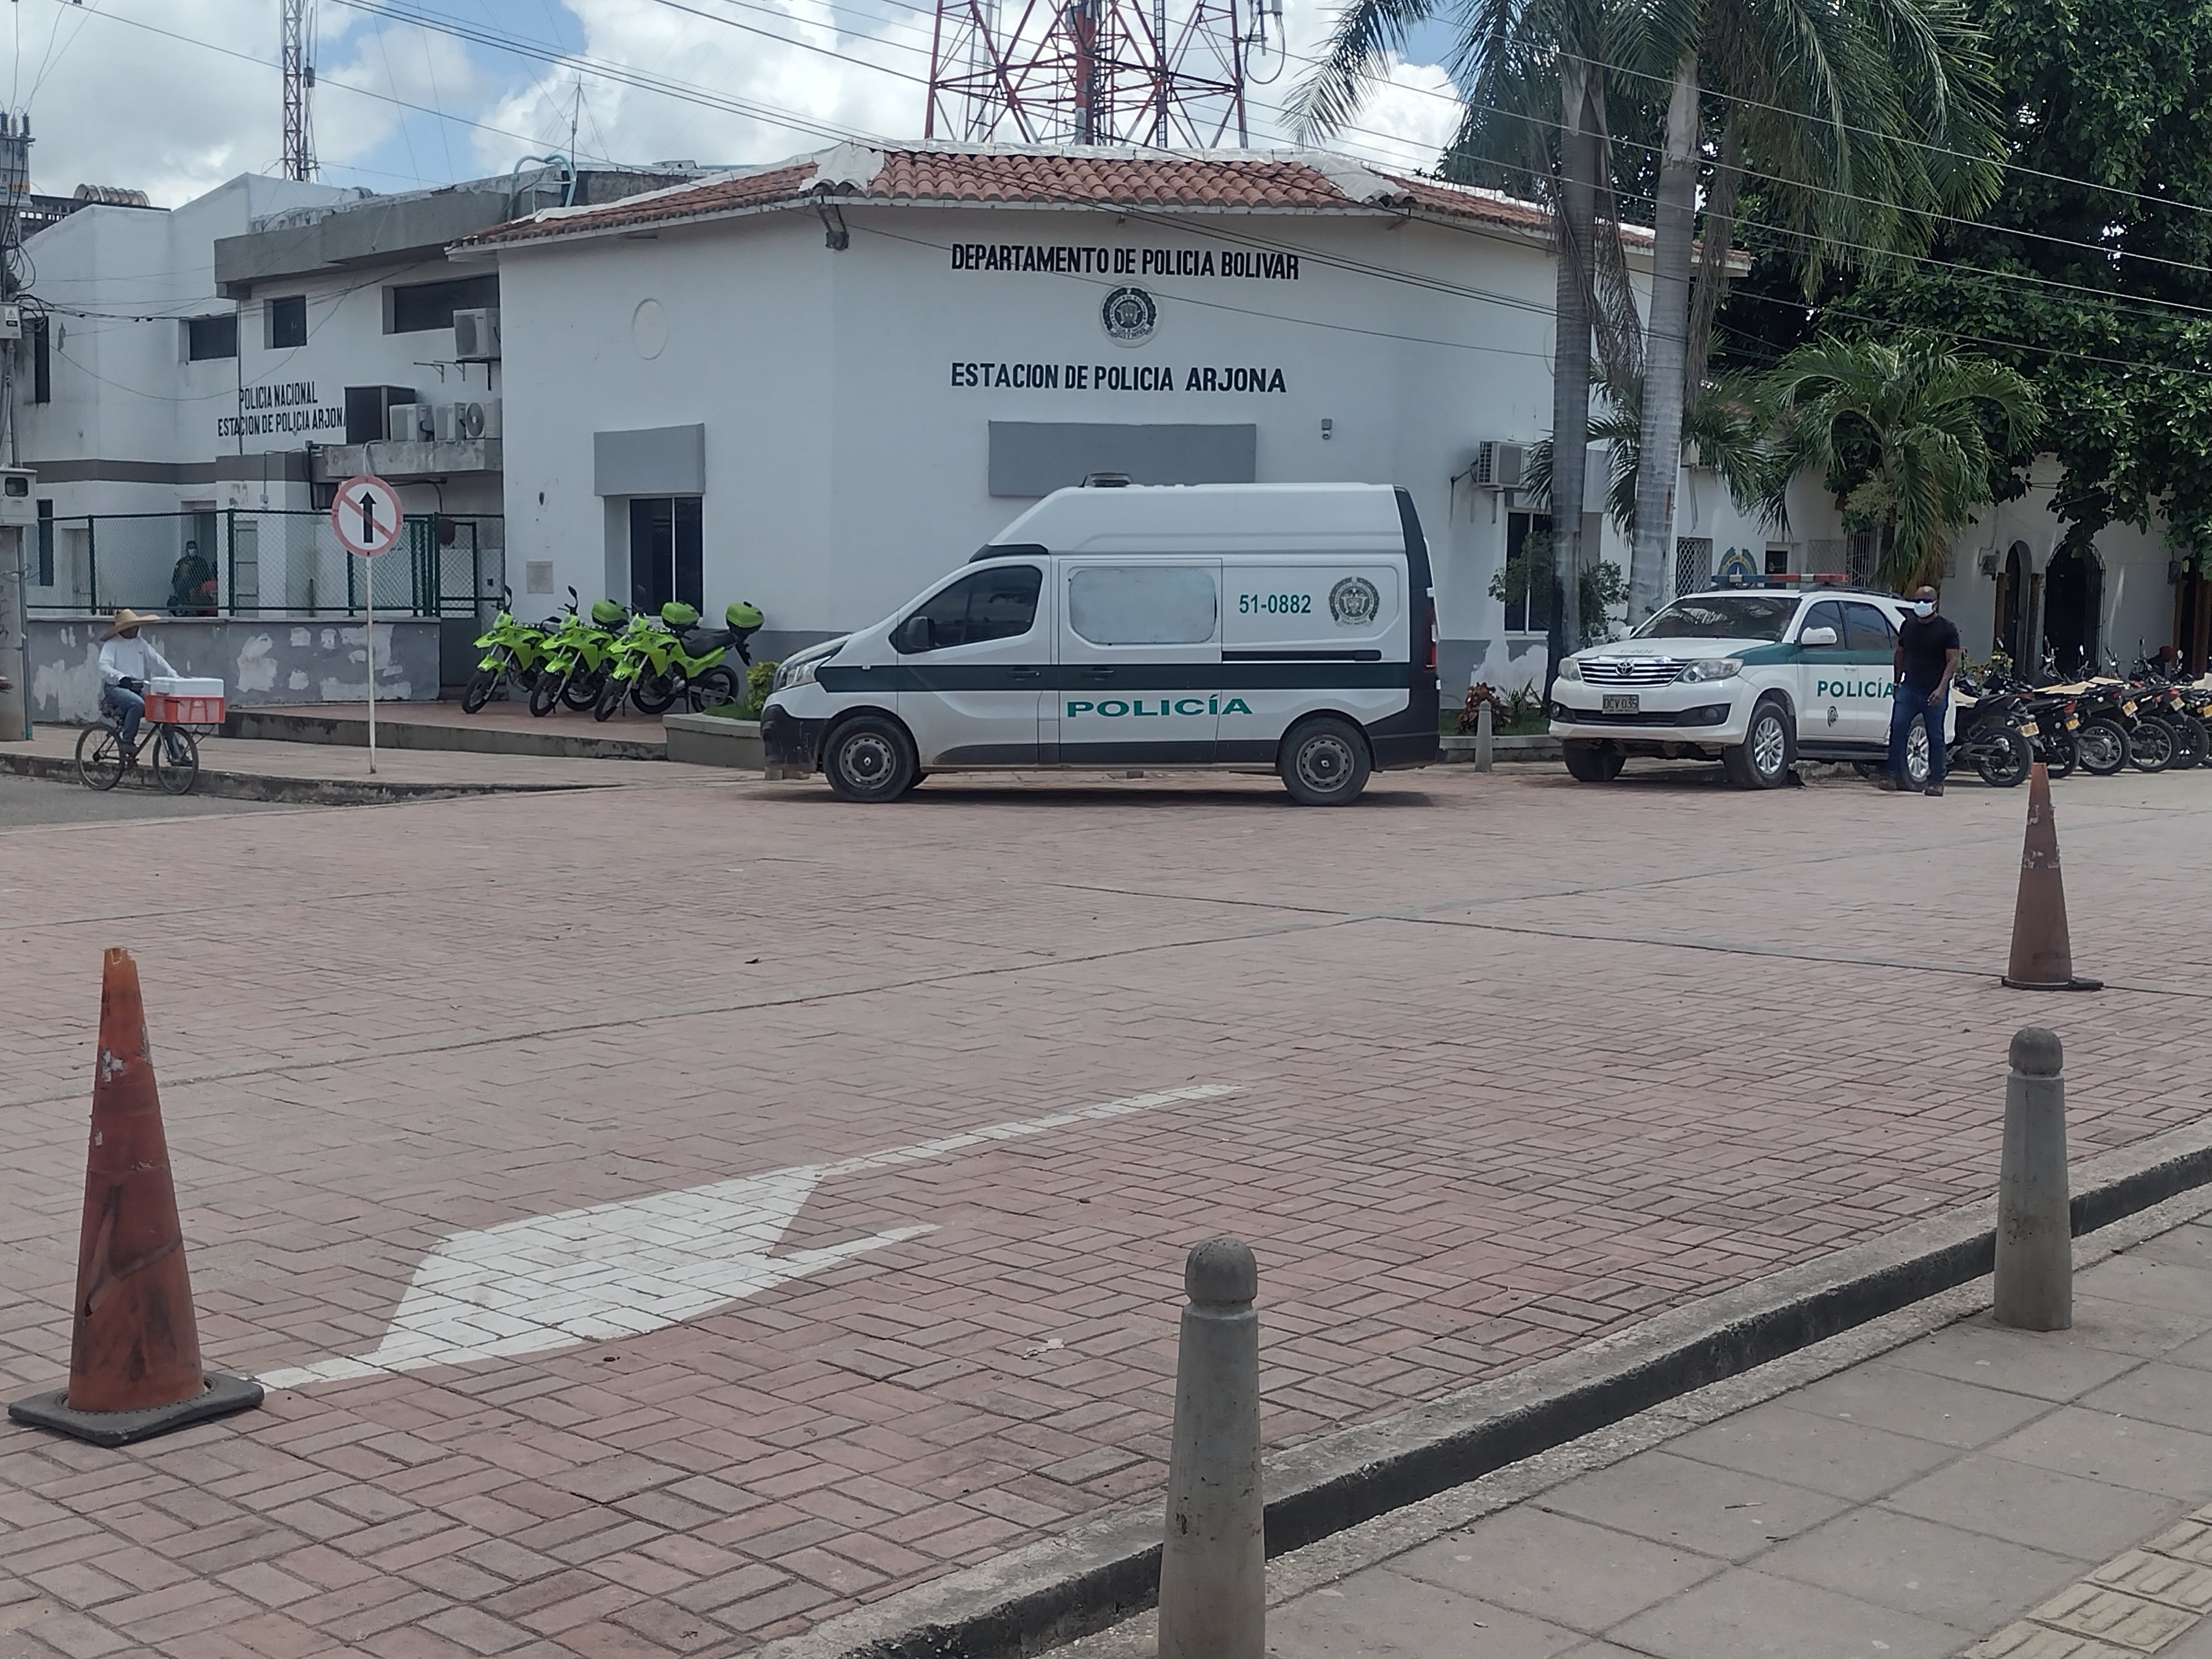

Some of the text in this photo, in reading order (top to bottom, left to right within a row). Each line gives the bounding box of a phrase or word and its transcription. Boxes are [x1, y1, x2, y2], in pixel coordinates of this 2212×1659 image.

[951, 243, 1299, 280] DEPARTAMENTO DE POLICIA BOLIVAR
[951, 362, 1287, 393] ESTACION DE POLICIA ARJONA
[239, 381, 318, 410] POLICIA NACIONAL
[218, 414, 260, 437] ESTACION
[262, 414, 274, 434] DE
[275, 410, 310, 434] POLICIA
[1239, 594, 1311, 614] 51-0882
[1817, 677, 1894, 698] POLICÍA
[1067, 694, 1253, 718] POLICÍA
